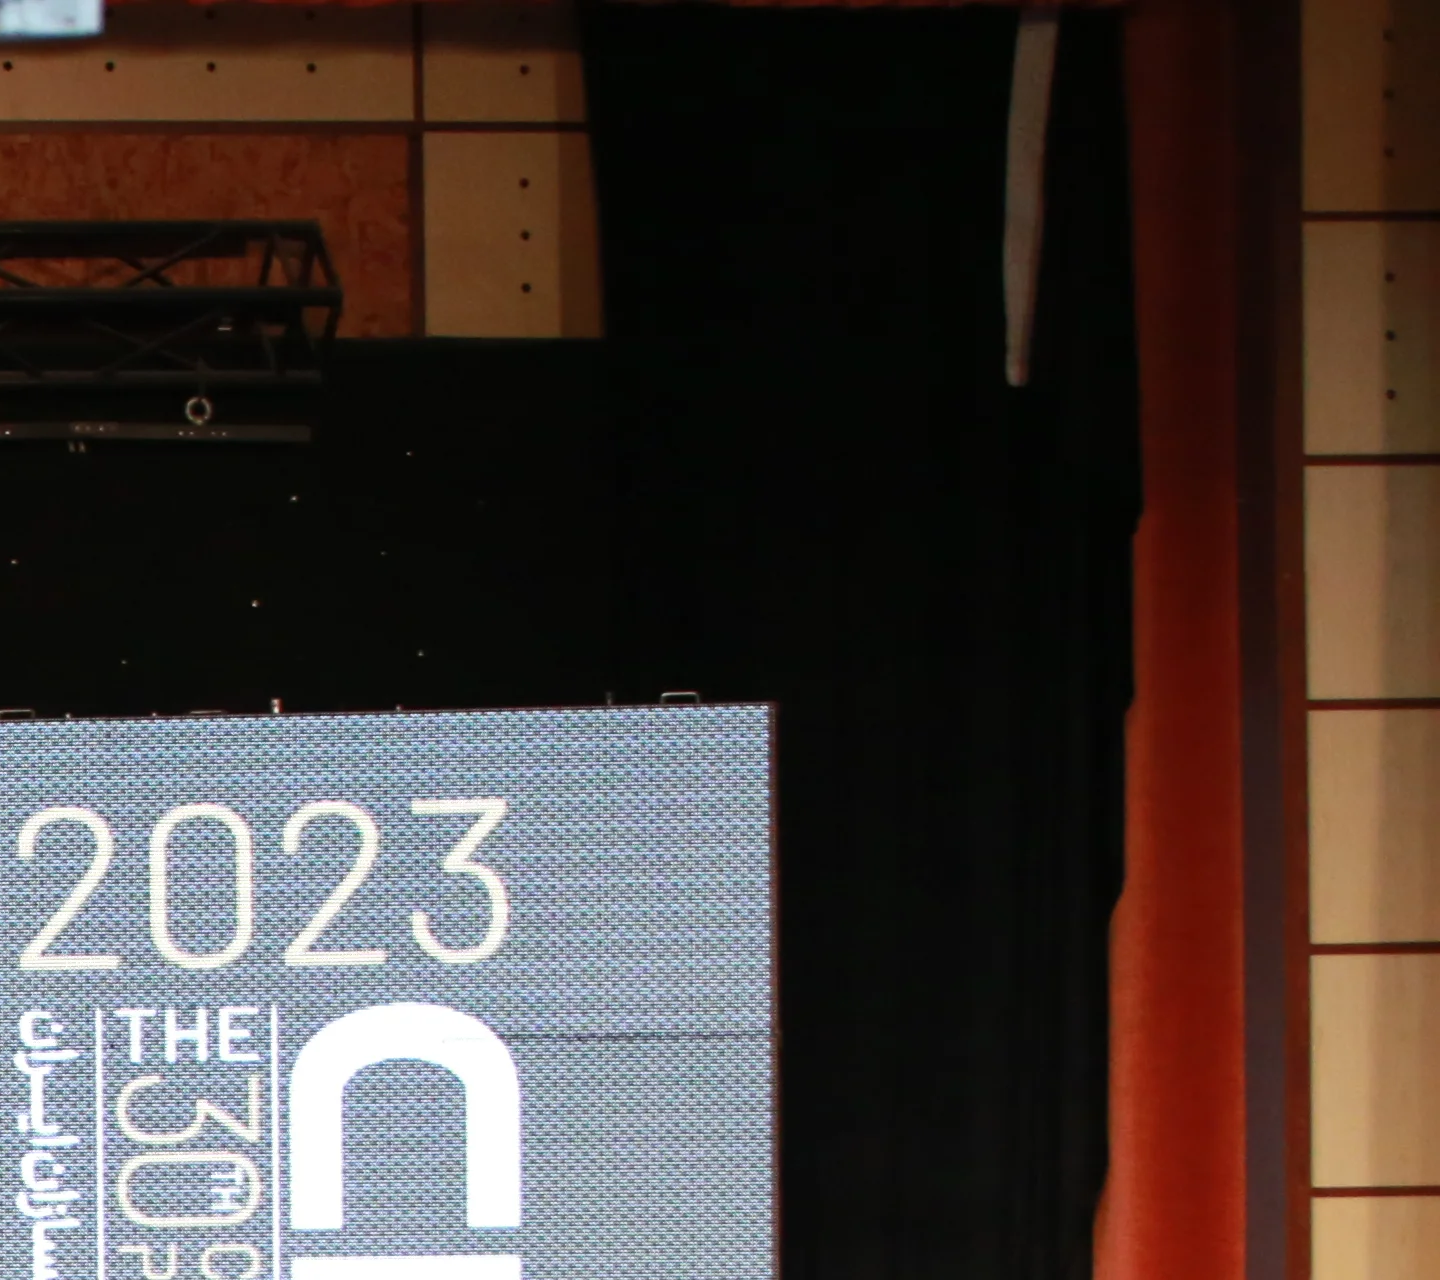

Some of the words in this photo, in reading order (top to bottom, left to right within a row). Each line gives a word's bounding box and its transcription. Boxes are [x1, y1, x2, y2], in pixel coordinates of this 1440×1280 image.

[16, 797, 510, 972] 2023
[115, 1006, 260, 1062] THE
[117, 1073, 262, 1226] 30
